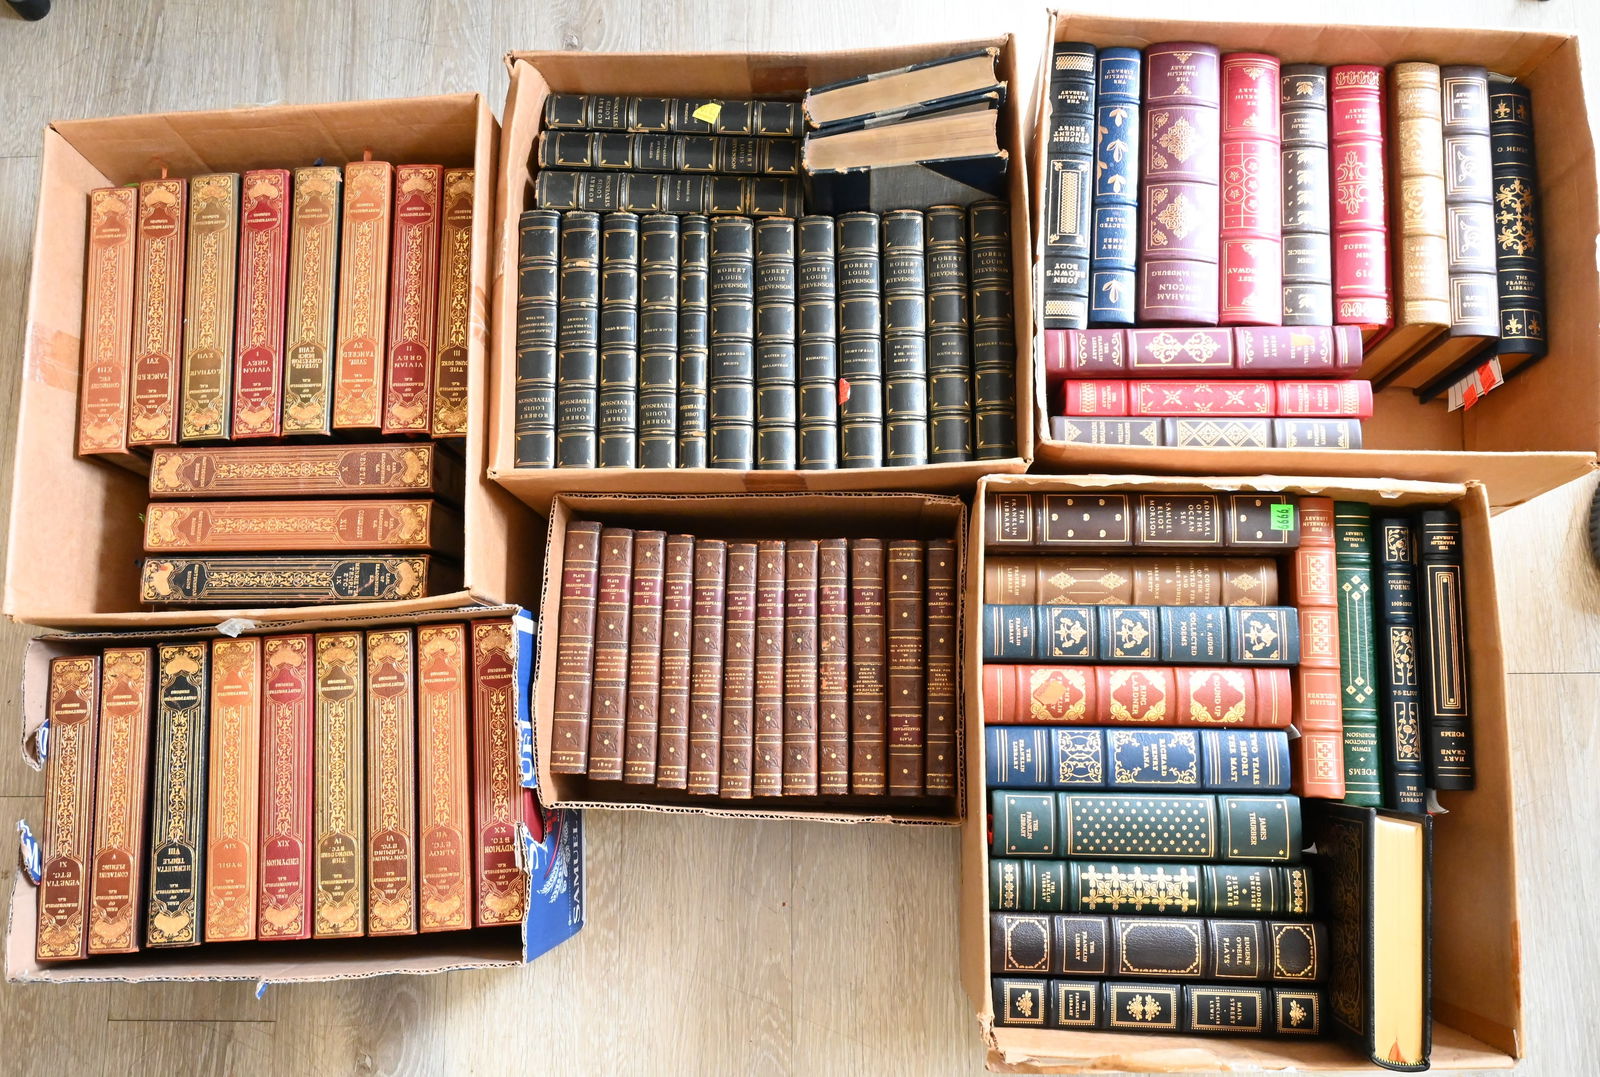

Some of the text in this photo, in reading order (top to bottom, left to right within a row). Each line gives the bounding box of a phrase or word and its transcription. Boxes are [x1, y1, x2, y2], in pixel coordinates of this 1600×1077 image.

[842, 278, 875, 286] STEVENSON
[1196, 505, 1201, 513] OF
[1132, 675, 1140, 714] LARDNER
[1151, 743, 1159, 771] HENRY
[1250, 733, 1258, 753] TWO
[1159, 739, 1167, 776] RICHARD
[1240, 741, 1248, 775] BEFORE
[1249, 812, 1257, 845] THURBER
[429, 849, 456, 857] ALROY
